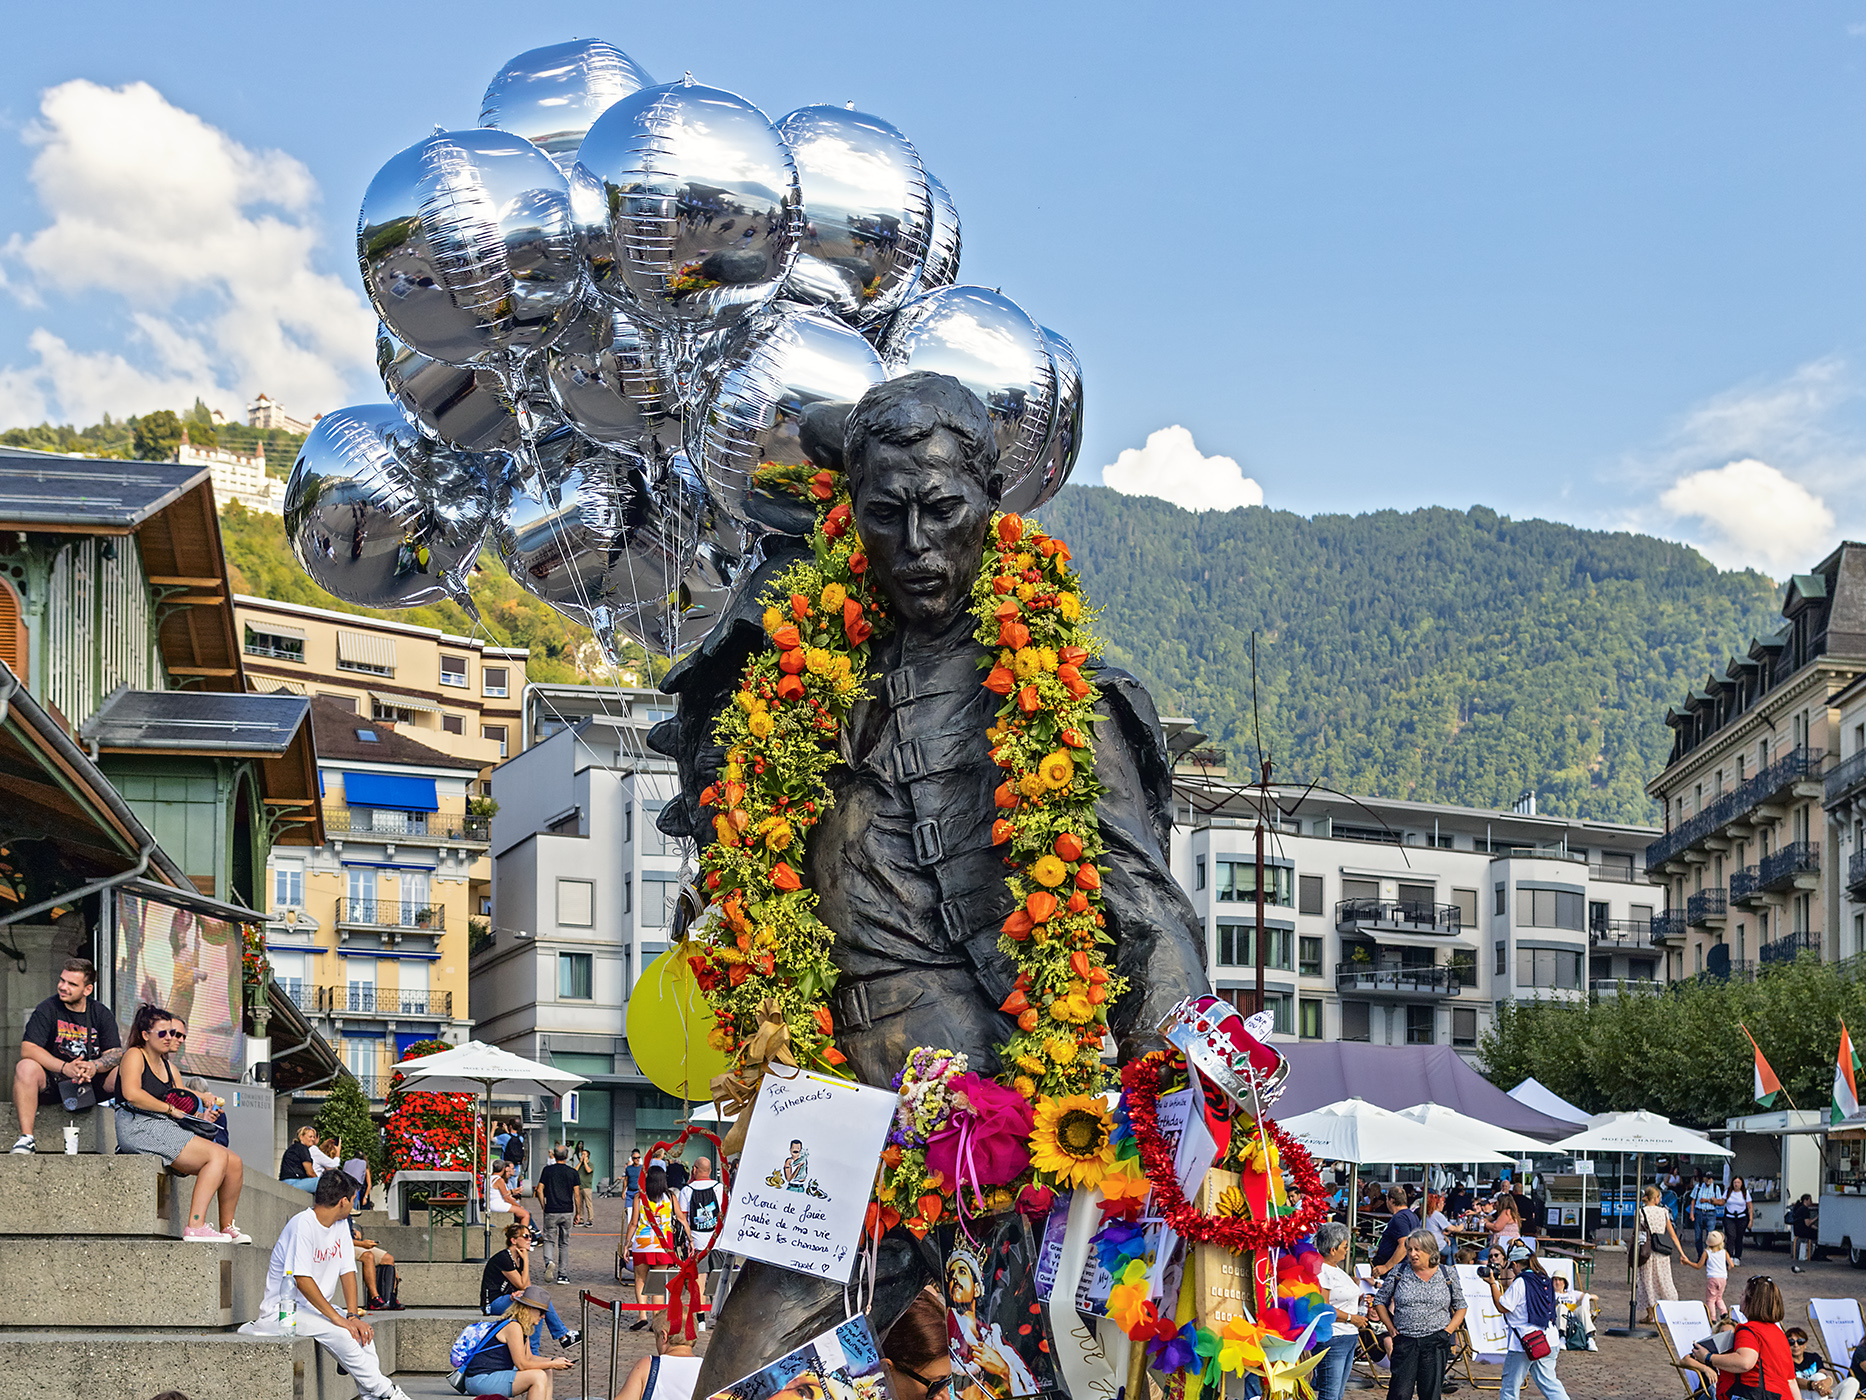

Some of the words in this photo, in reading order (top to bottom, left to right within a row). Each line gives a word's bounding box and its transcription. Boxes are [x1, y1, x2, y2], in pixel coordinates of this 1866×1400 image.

[241, 1092, 264, 1100] COMMUNE
[767, 1083, 790, 1097] FOR
[241, 1100, 271, 1110] MONTREUX
[783, 1202, 796, 1215] de
[776, 1218, 788, 1230] de
[814, 1227, 832, 1241] vie
